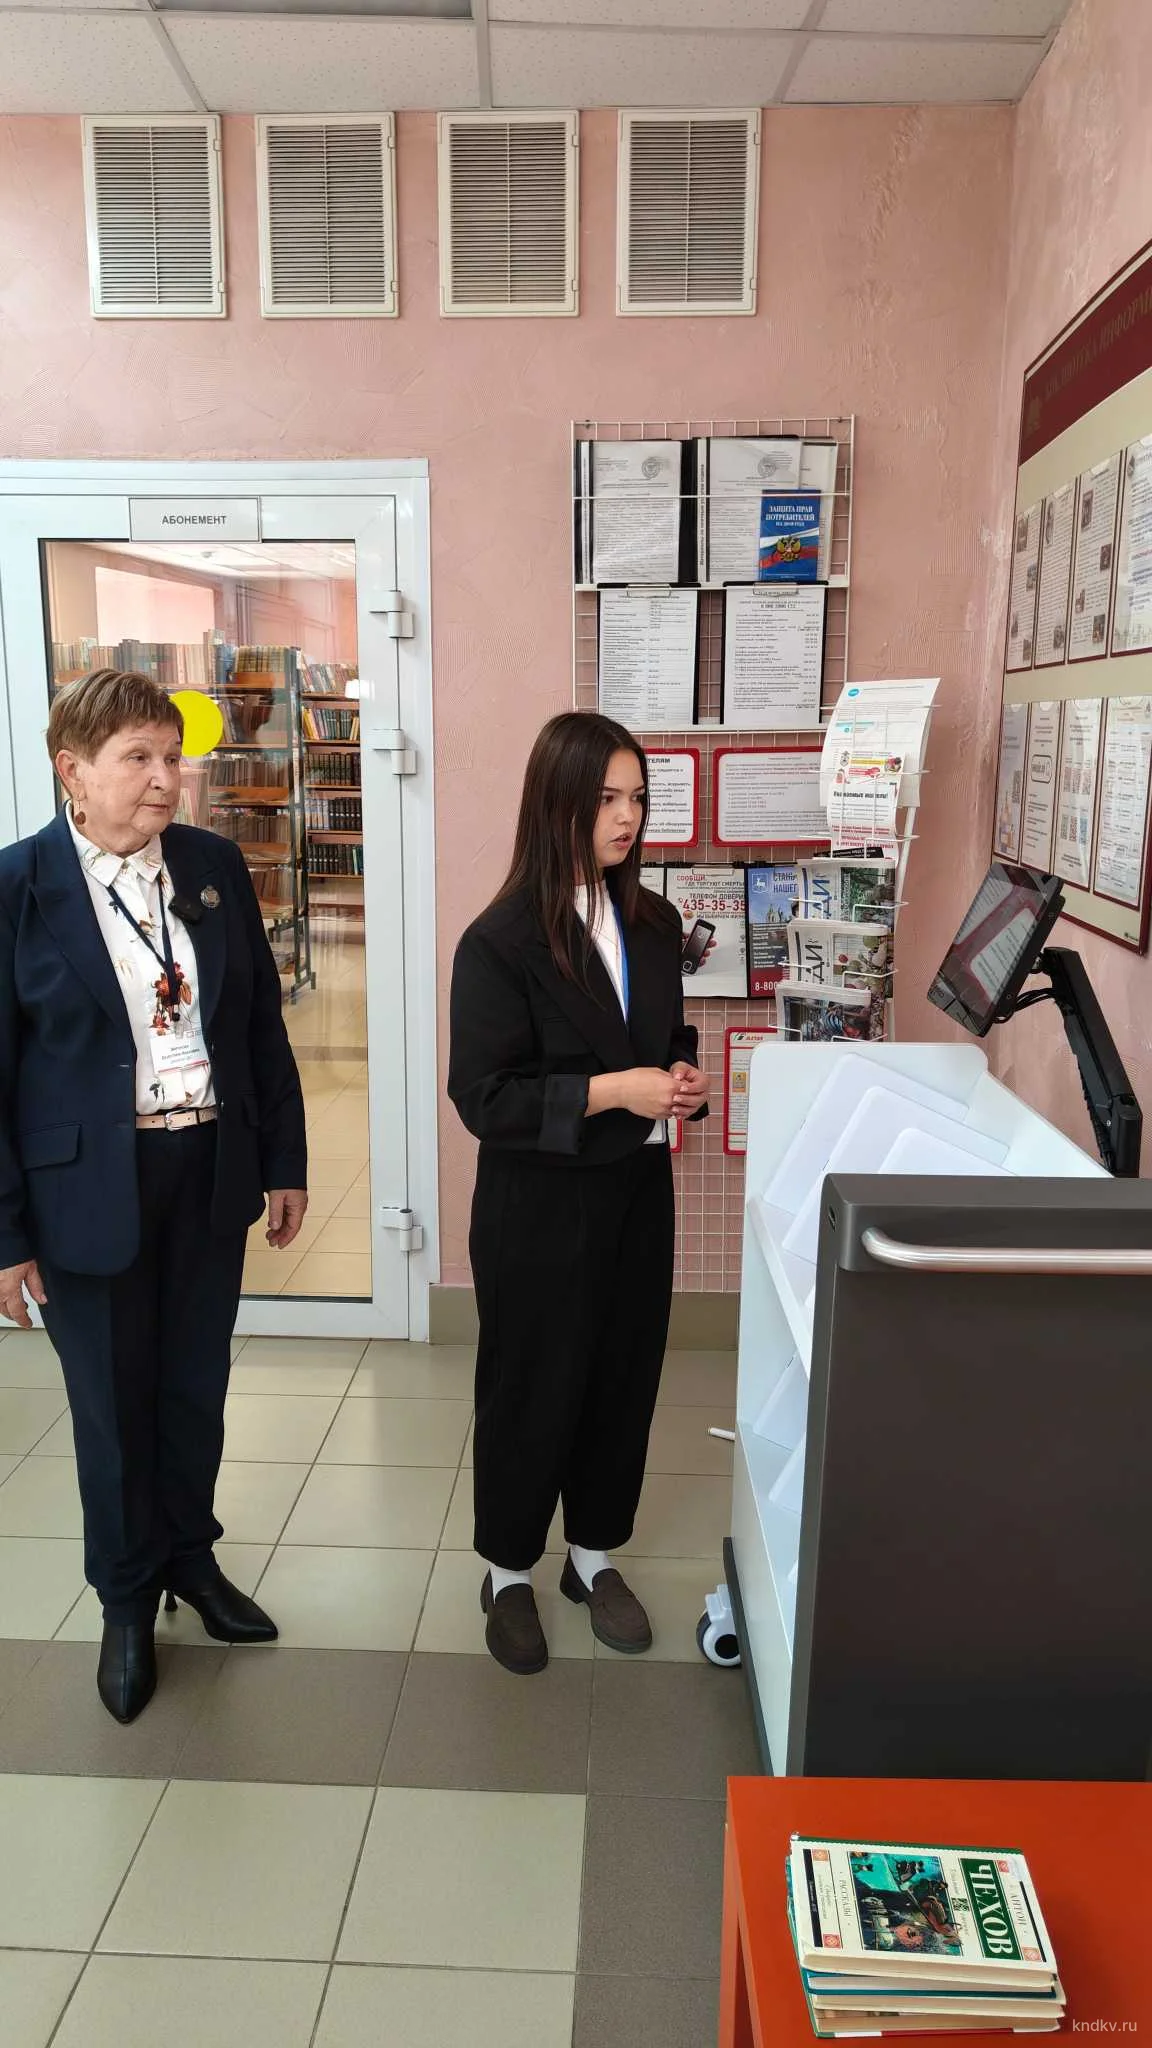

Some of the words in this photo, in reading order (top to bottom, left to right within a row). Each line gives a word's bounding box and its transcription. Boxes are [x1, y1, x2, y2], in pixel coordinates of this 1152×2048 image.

[161, 515, 227, 525] АБОНЕМЕНТ
[765, 513, 815, 521] ПОТРЕБИТЕЛЕЙ
[773, 883, 798, 893] НАШЕГ
[682, 899, 746, 911] 435-35-35
[839, 1880, 853, 1917] РАССКАЗЫ
[969, 1864, 1013, 1954] ЧЕХОВ
[1010, 1895, 1027, 1926] АНТОН
